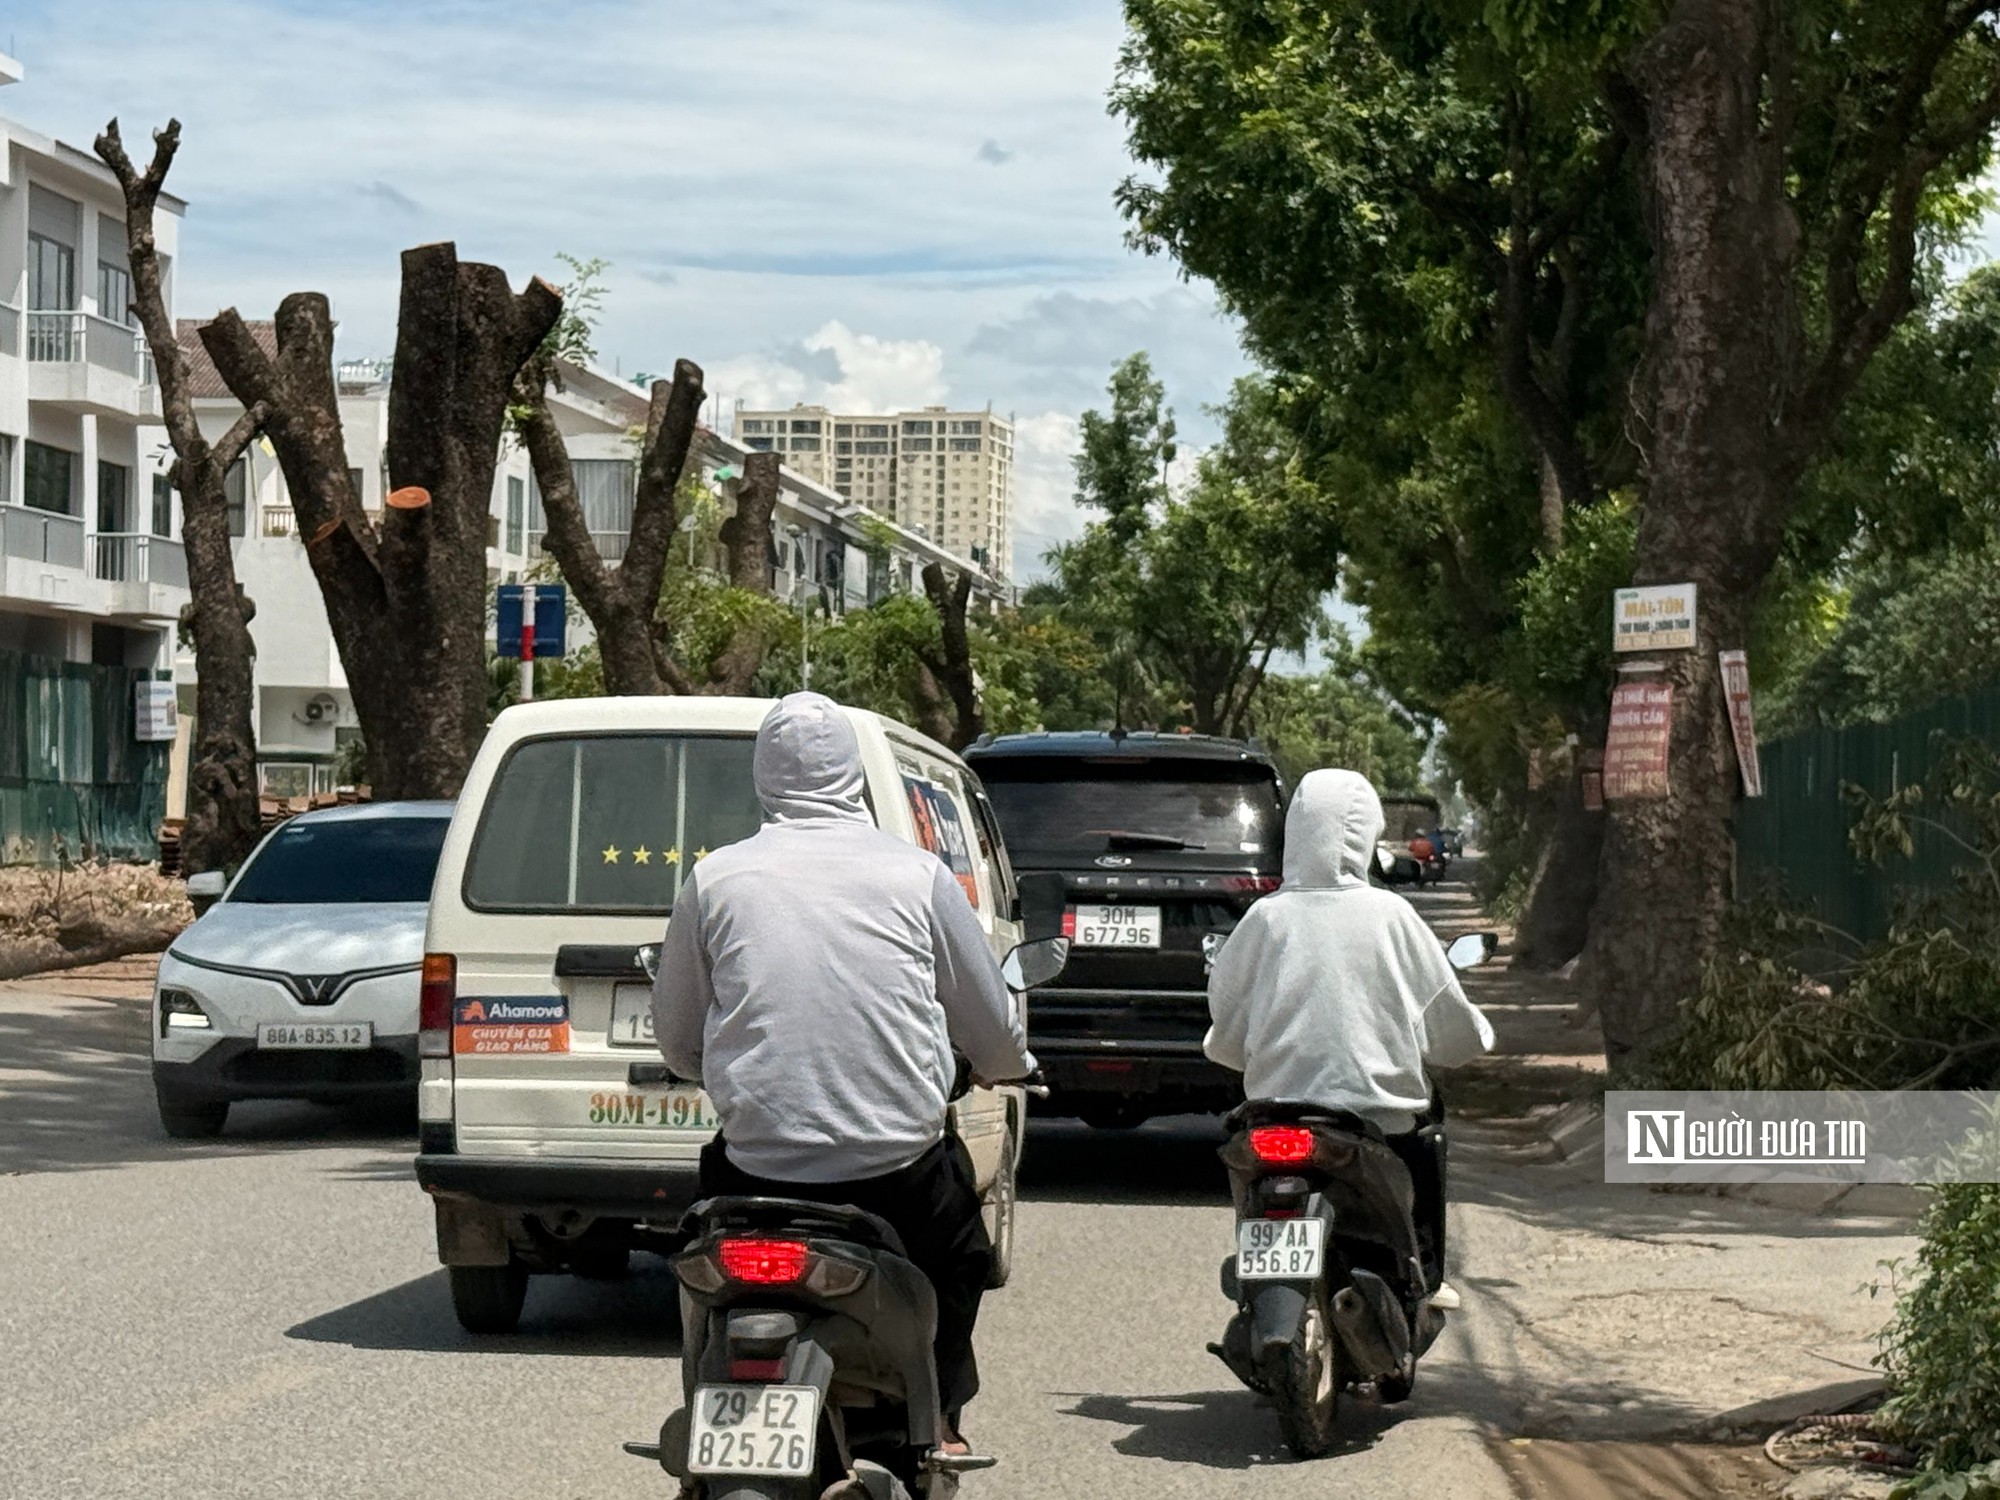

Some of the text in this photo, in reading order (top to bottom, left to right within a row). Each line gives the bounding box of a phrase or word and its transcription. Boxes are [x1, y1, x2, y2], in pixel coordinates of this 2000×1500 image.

[1100, 908, 1136, 926] 30M
[1083, 927, 1151, 944] 677.96
[489, 1003, 564, 1018] Ahamove
[527, 1028, 552, 1039] GIA
[589, 1093, 720, 1126] 30M-191.
[1250, 1222, 1308, 1248] 99-AA
[1242, 1250, 1315, 1274] 556.87
[711, 1391, 799, 1430] 29-E2
[698, 1431, 805, 1470] 825.26
